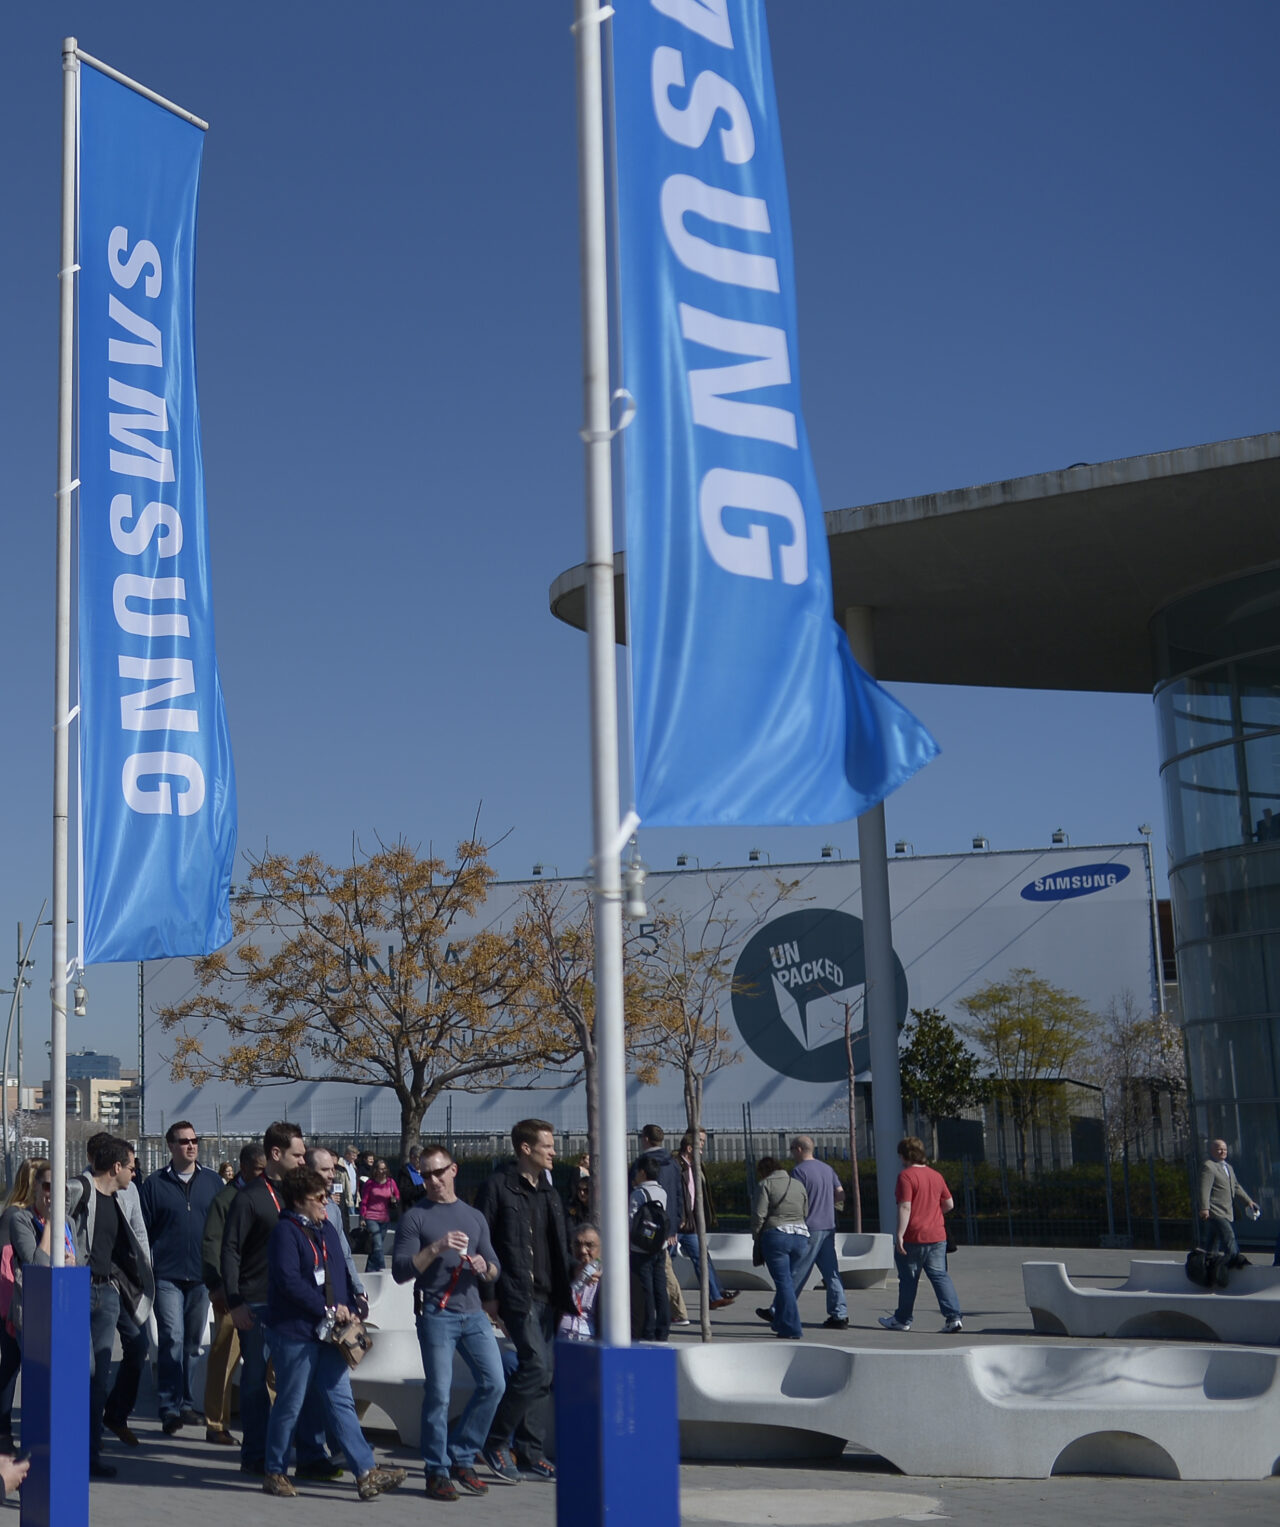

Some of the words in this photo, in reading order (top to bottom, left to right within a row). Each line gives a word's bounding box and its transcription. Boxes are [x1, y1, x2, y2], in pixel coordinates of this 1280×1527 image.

[107, 225, 207, 817] SAMSUNG
[1034, 873, 1117, 892] SAMSUNG
[769, 940, 800, 968] UN
[777, 958, 844, 988] PACKED
